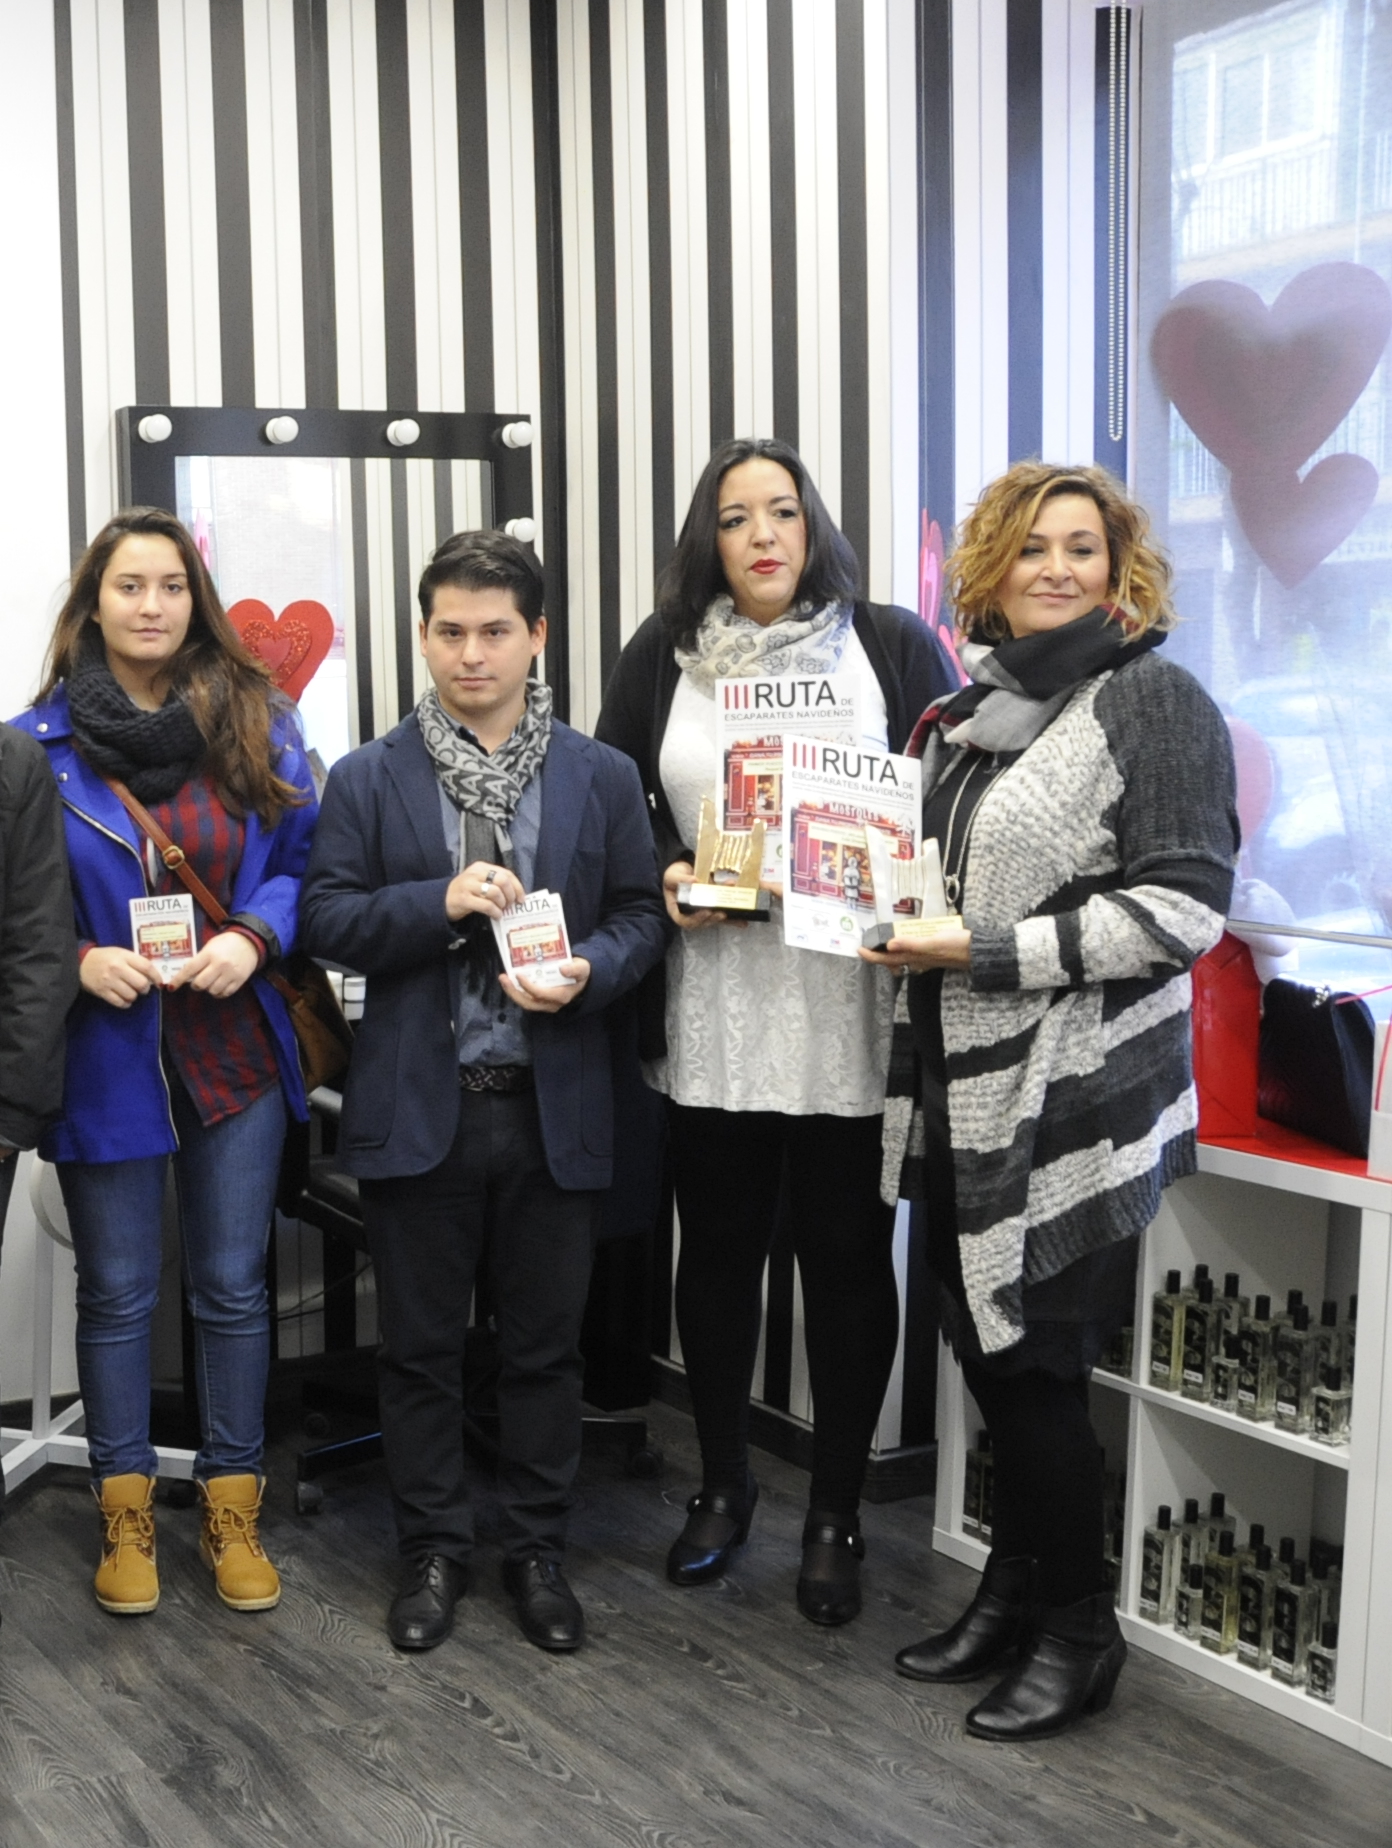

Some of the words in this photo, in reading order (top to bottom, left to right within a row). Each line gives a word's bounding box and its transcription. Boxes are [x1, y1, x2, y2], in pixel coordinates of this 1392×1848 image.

[754, 680, 837, 710] RUTA
[841, 698, 854, 706] DE
[724, 711, 794, 721] ESCAPARATES
[796, 708, 855, 720] NAVIDEÑOS
[821, 747, 899, 787] RUTA
[902, 780, 915, 790] DE
[791, 770, 860, 792] ESCAPARATES
[147, 898, 182, 911] RUTA
[514, 898, 551, 914] RUTA
